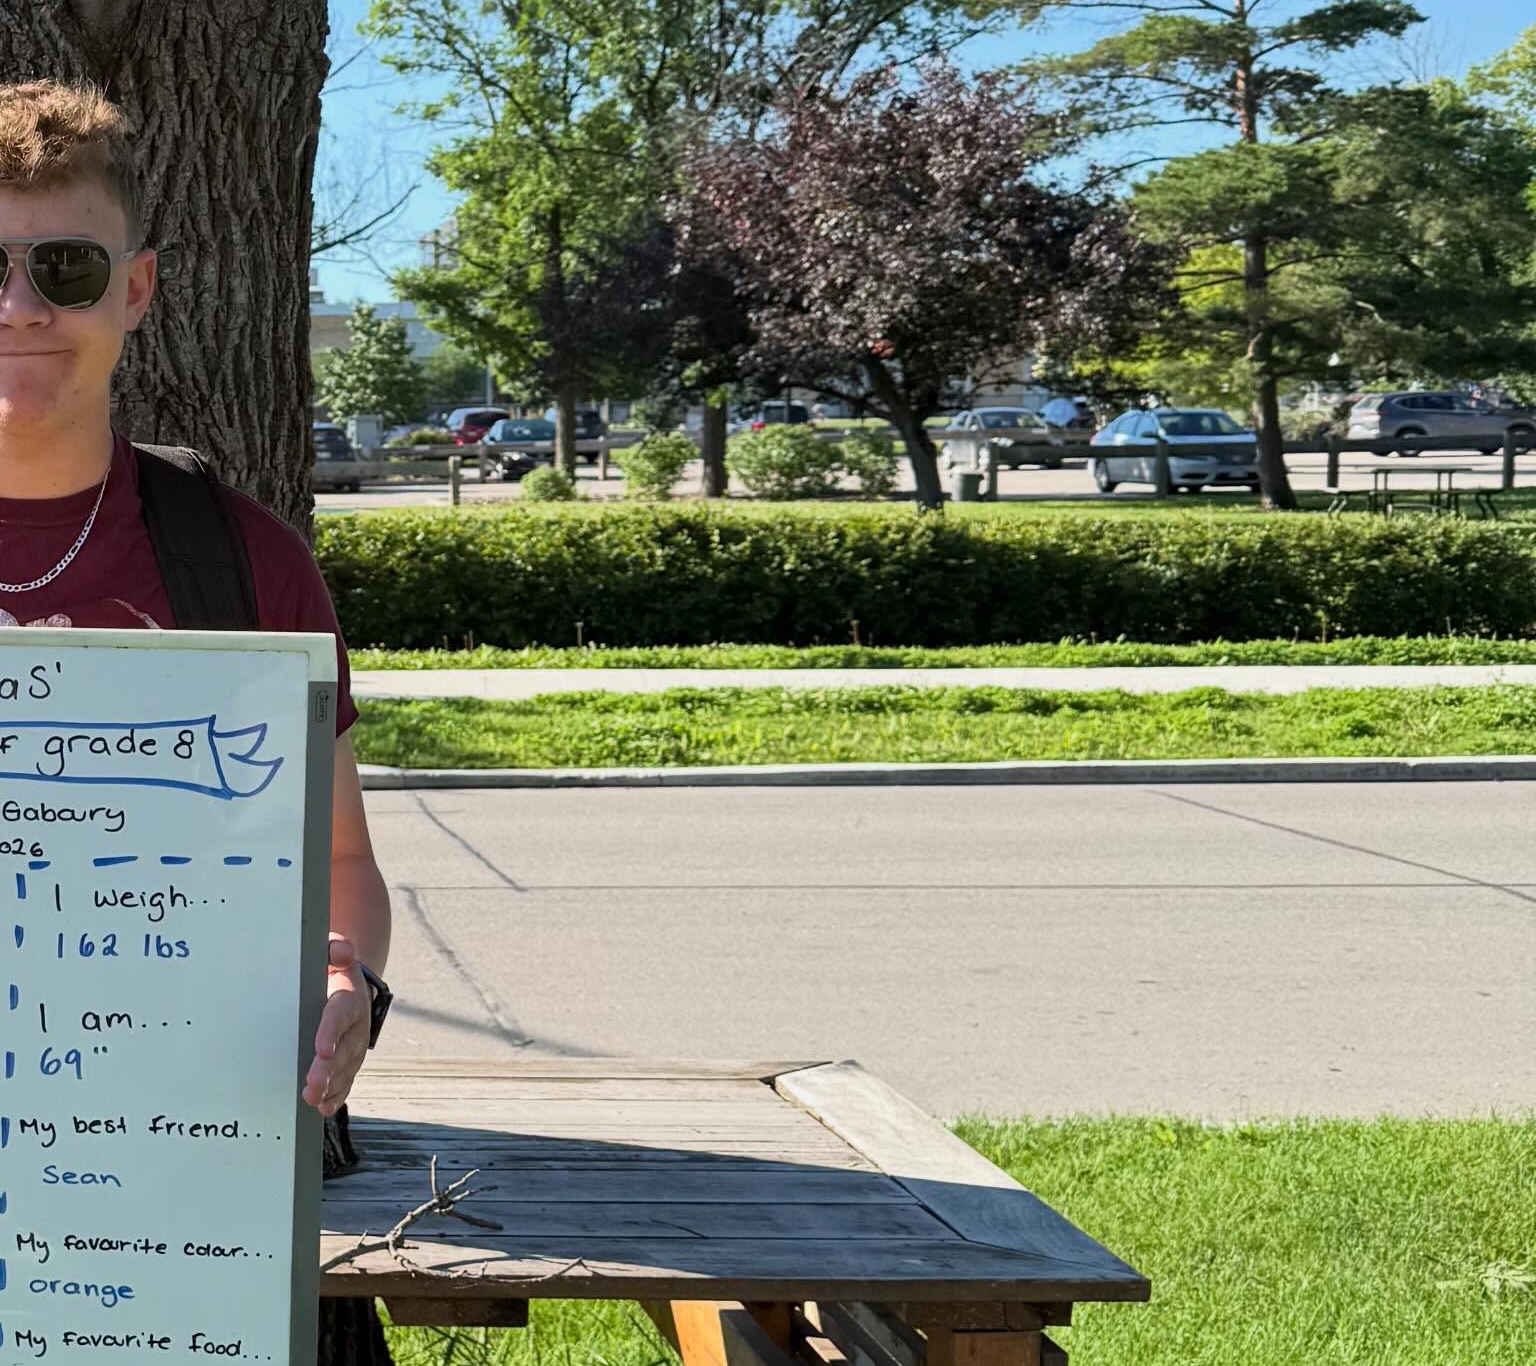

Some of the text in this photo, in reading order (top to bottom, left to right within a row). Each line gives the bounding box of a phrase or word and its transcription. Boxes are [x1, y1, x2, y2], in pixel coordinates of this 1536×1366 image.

[36, 728, 157, 777] grade
[173, 730, 194, 759] 8
[2, 801, 125, 832] Gaboury
[94, 885, 226, 922] weigh...
[57, 933, 190, 958] 162 lbs
[81, 1011, 192, 1032] am...
[20, 1117, 57, 1148] My
[73, 1115, 126, 1134] best
[42, 1165, 121, 1187] Sean
[16, 1232, 50, 1264] My
[63, 1235, 167, 1255] favourite
[29, 1279, 135, 1308] orange
[15, 1329, 272, 1360] My favourite food...
